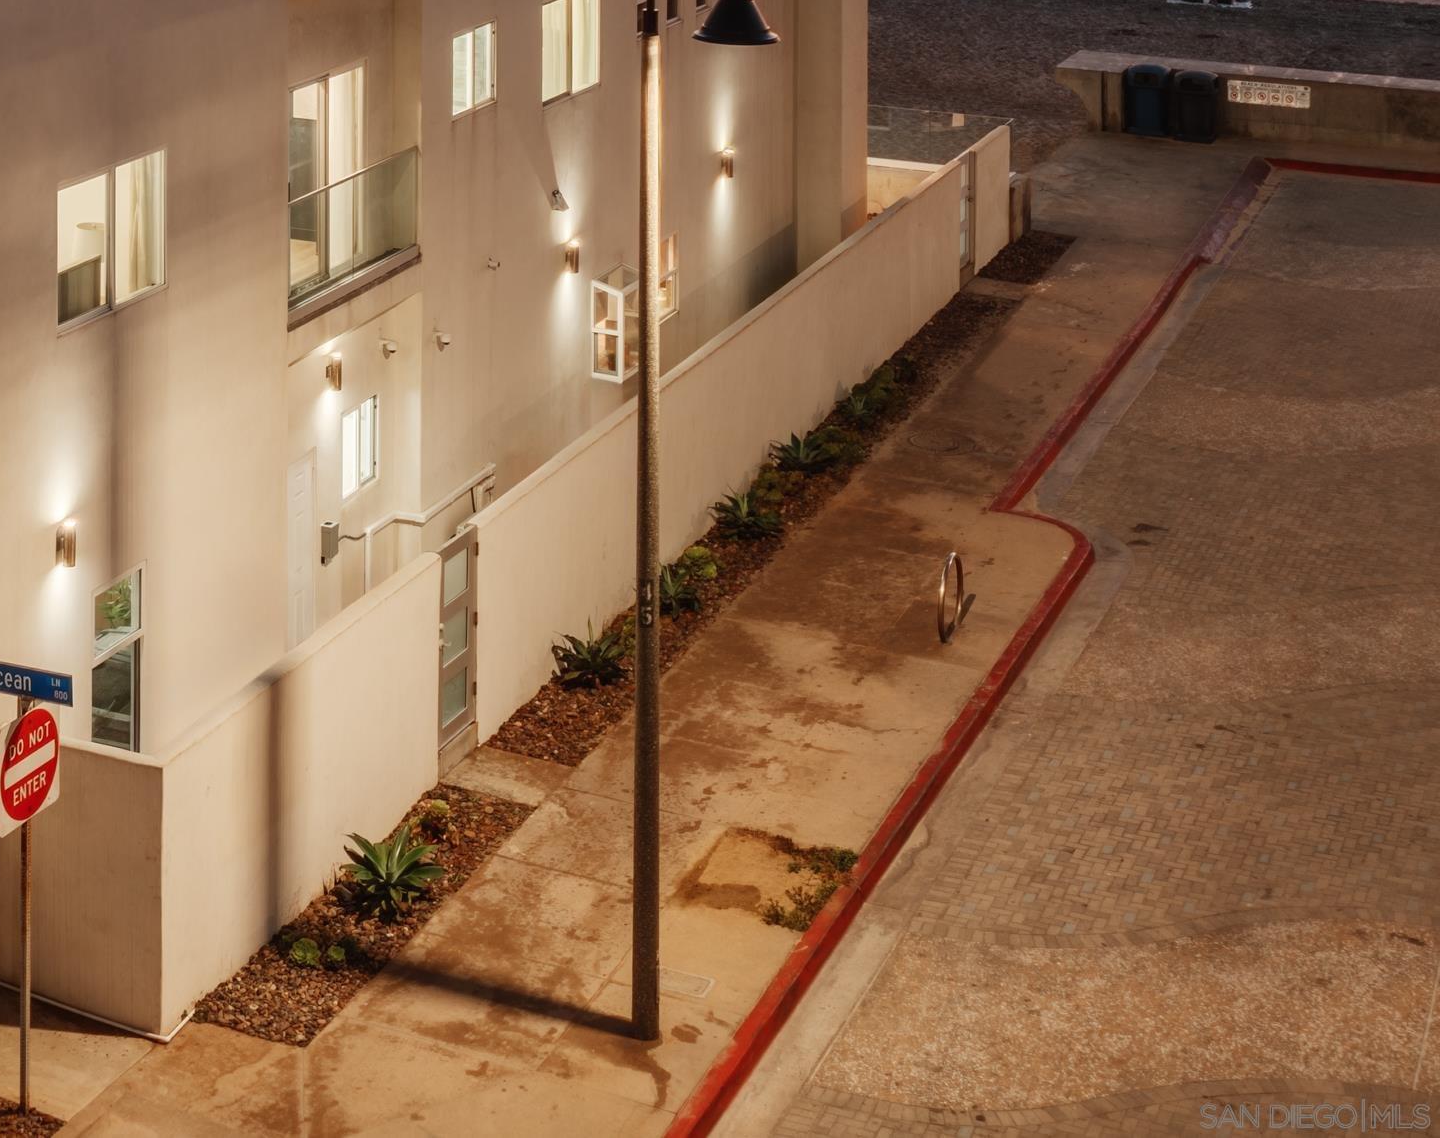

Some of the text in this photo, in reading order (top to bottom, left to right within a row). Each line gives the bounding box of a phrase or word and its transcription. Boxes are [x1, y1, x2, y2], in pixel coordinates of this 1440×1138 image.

[51, 677, 61, 688] LN
[54, 690, 68, 700] 800
[9, 720, 51, 761] DO NOT
[13, 770, 47, 807] ENTER
